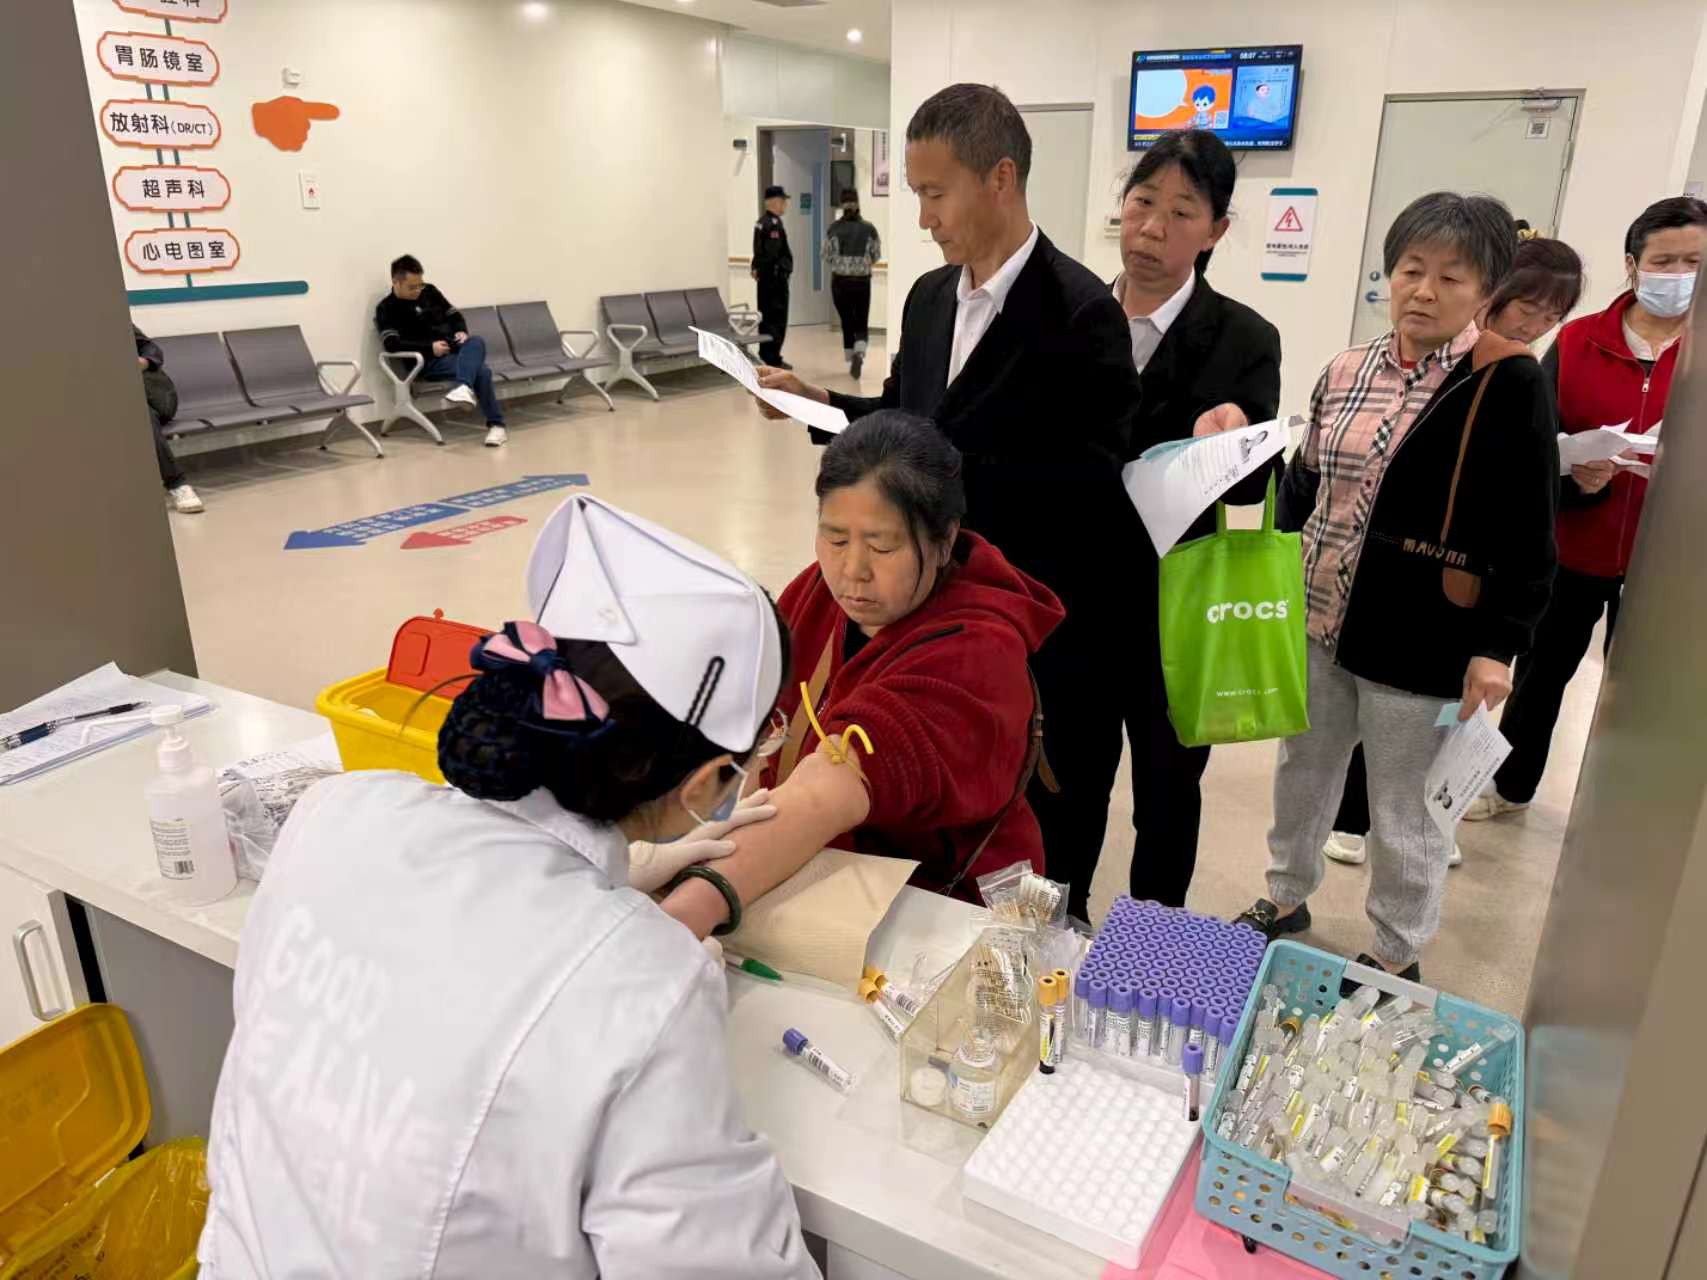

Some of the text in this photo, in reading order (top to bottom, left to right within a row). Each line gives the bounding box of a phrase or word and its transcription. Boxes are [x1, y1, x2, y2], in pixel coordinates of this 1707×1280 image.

[115, 44, 205, 73] 胃肠镜室
[142, 179, 205, 199] 超声科
[142, 240, 226, 261] 心电图室
[1207, 600, 1288, 624] crocs
